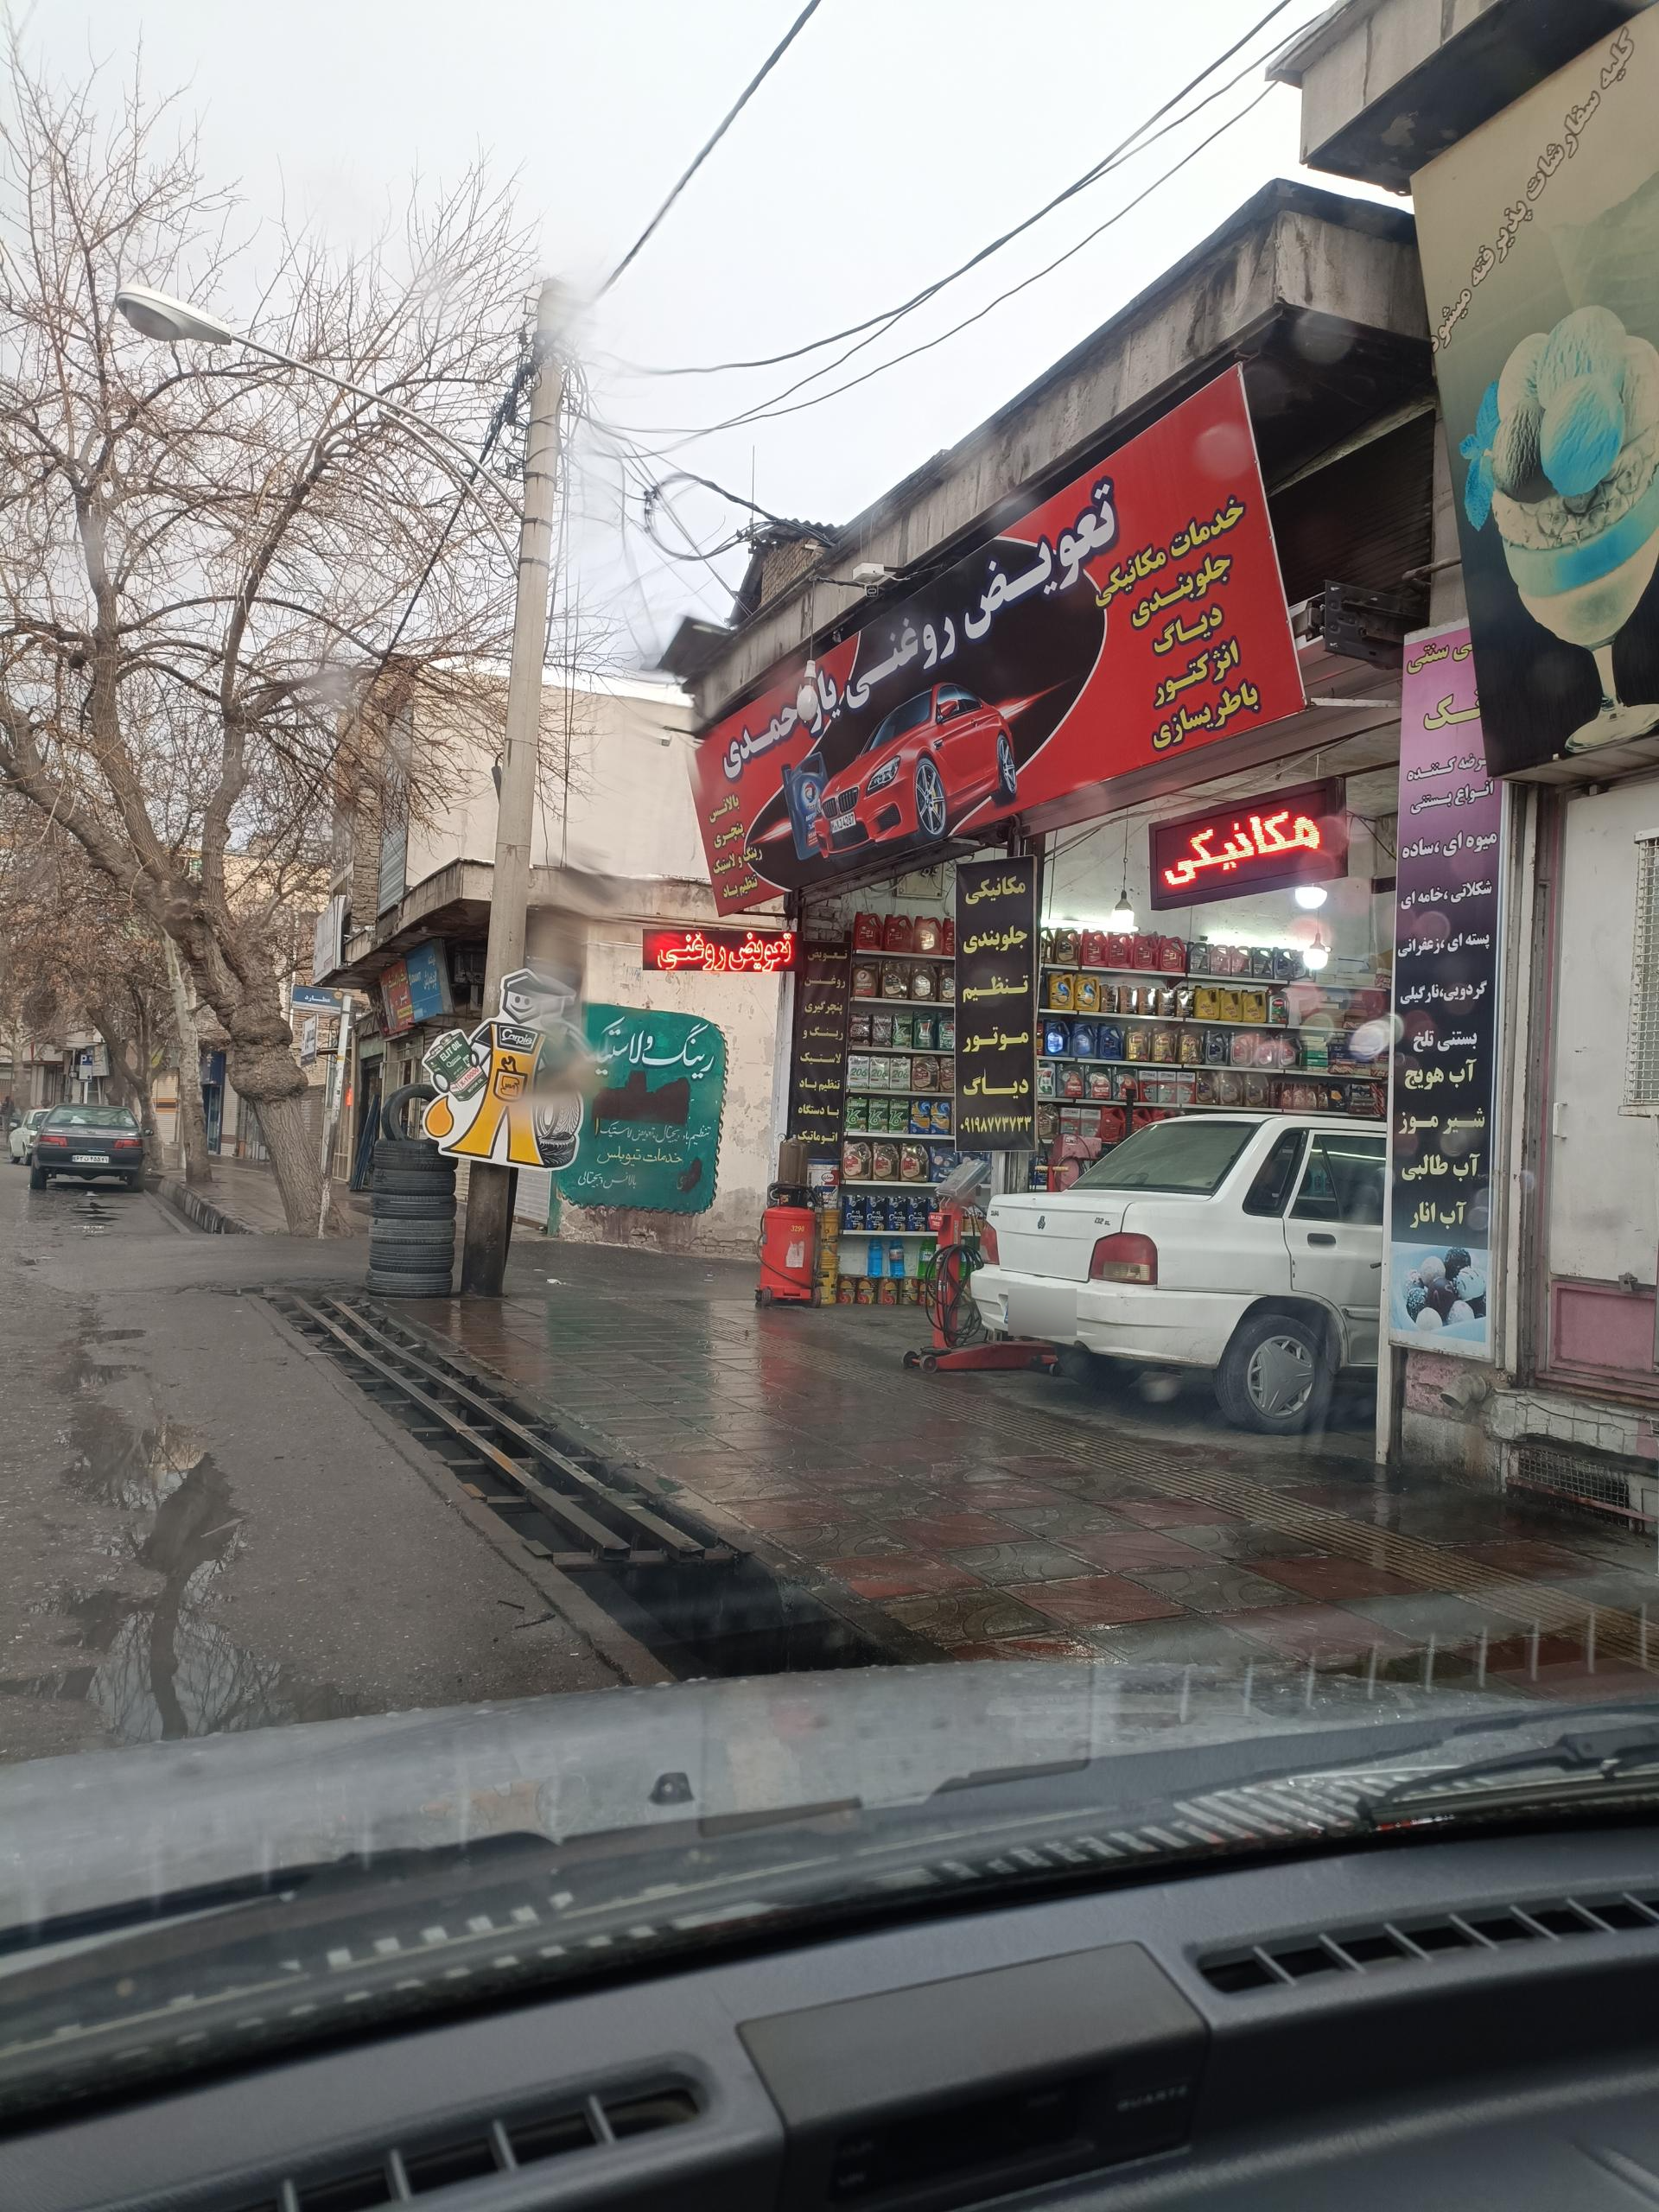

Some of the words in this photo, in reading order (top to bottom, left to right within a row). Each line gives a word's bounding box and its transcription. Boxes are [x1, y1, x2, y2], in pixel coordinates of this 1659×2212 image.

[1599, 25, 1635, 90] کلیه
[1526, 90, 1601, 201] سفارشات
[1471, 200, 1534, 287] پذیرفته
[1171, 499, 1244, 557] خدمات
[963, 483, 1116, 640] تعویض
[1095, 546, 1166, 607] مکانیکی
[1131, 554, 1231, 627] جلوبندی
[1153, 607, 1224, 653] دیاگ
[847, 617, 957, 709] روغنی
[1407, 643, 1450, 675] سنتی
[1407, 756, 1458, 782] کننده
[1458, 753, 1487, 772] رضه
[1409, 790, 1452, 815] بستنی
[1454, 779, 1494, 805] انواع
[709, 794, 740, 822] بالانس
[714, 823, 745, 849] پنچری
[1164, 810, 1321, 886] مکانیکی
[1442, 830, 1464, 857] ای
[1465, 831, 1497, 853] میوه
[713, 853, 736, 874] لاستیک
[742, 846, 763, 861] رینگ
[722, 881, 740, 899] باد
[740, 874, 759, 893] تنظیم
[964, 875, 1027, 906] مکانیکی
[1450, 879, 1493, 904] شکلاتی
[1400, 891, 1415, 910] ای
[657, 931, 728, 971] روغنی
[728, 931, 792, 973] تعویض
[963, 925, 1028, 954] جلوبندی
[1447, 933, 1463, 952] ای
[1465, 931, 1491, 950] پسته
[807, 949, 849, 963] تعویض
[804, 976, 846, 988] روغن
[962, 974, 1029, 1003] تنظیم
[804, 1001, 843, 1014] پنچرگیری
[809, 1027, 843, 1040] رینگ
[962, 1027, 1029, 1052] موتور
[1413, 1029, 1435, 1052] تلخ
[1437, 1030, 1478, 1052] بستنی
[439, 1046, 454, 1062] ELIT
[450, 1039, 463, 1052] OIL
[642, 1022, 715, 1079] رینگ
[799, 1052, 842, 1065] لاستیک
[798, 1078, 817, 1090] باد
[818, 1079, 841, 1091] تنظیم
[963, 1070, 1029, 1101] دیاگ
[1403, 1065, 1445, 1090] هویج
[1449, 1058, 1478, 1089] آب
[798, 1103, 825, 1116] دستگاه
[826, 1105, 840, 1116] با
[1442, 1107, 1485, 1135] شیر
[1397, 1111, 1439, 1135] موز
[797, 1130, 838, 1143] اتوماتیک
[642, 1147, 683, 1164] خدمات
[1401, 1154, 1449, 1182] طالبی
[1452, 1154, 1481, 1184] آب
[1410, 1201, 1436, 1229] انار
[1440, 1200, 1467, 1230] آب
